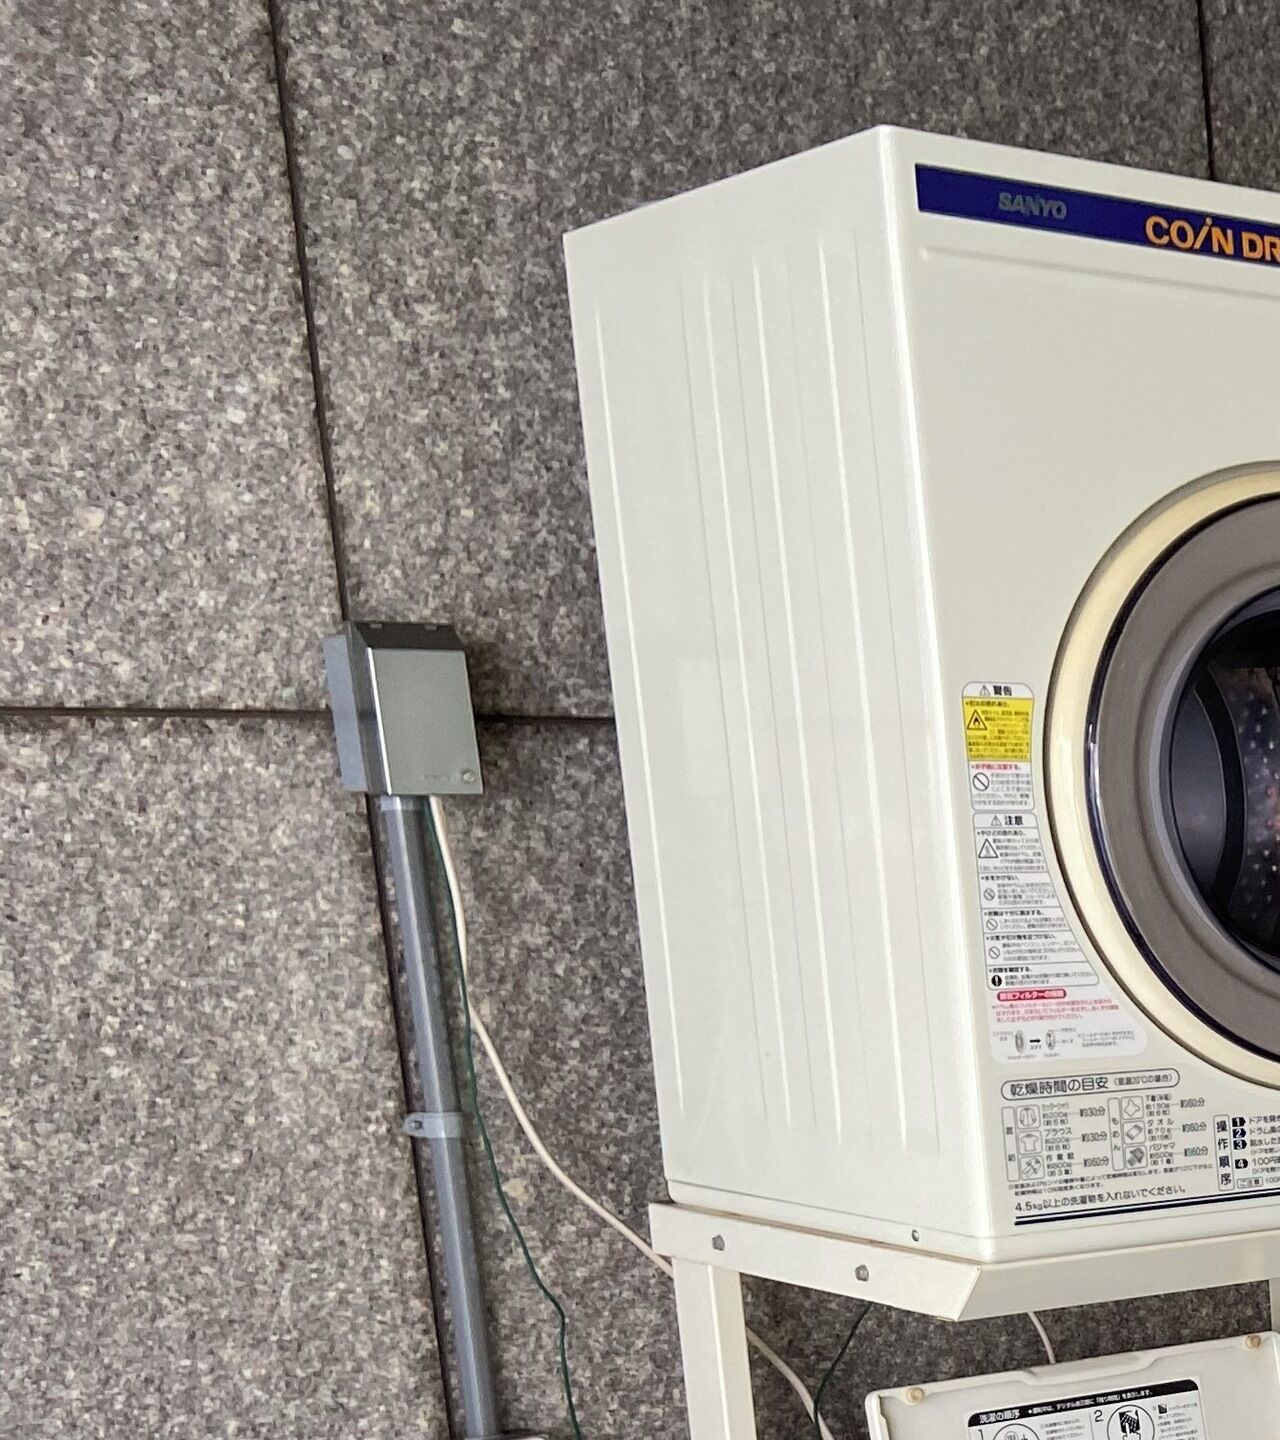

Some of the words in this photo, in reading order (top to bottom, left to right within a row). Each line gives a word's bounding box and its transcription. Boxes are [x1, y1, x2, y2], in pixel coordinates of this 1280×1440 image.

[998, 192, 1066, 220] SANYO
[1004, 815, 1023, 826] 注意
[1010, 1077, 1109, 1096] 乾燥時間の目安
[1094, 1410, 1103, 1422] 2
[978, 1429, 985, 1440] 1
